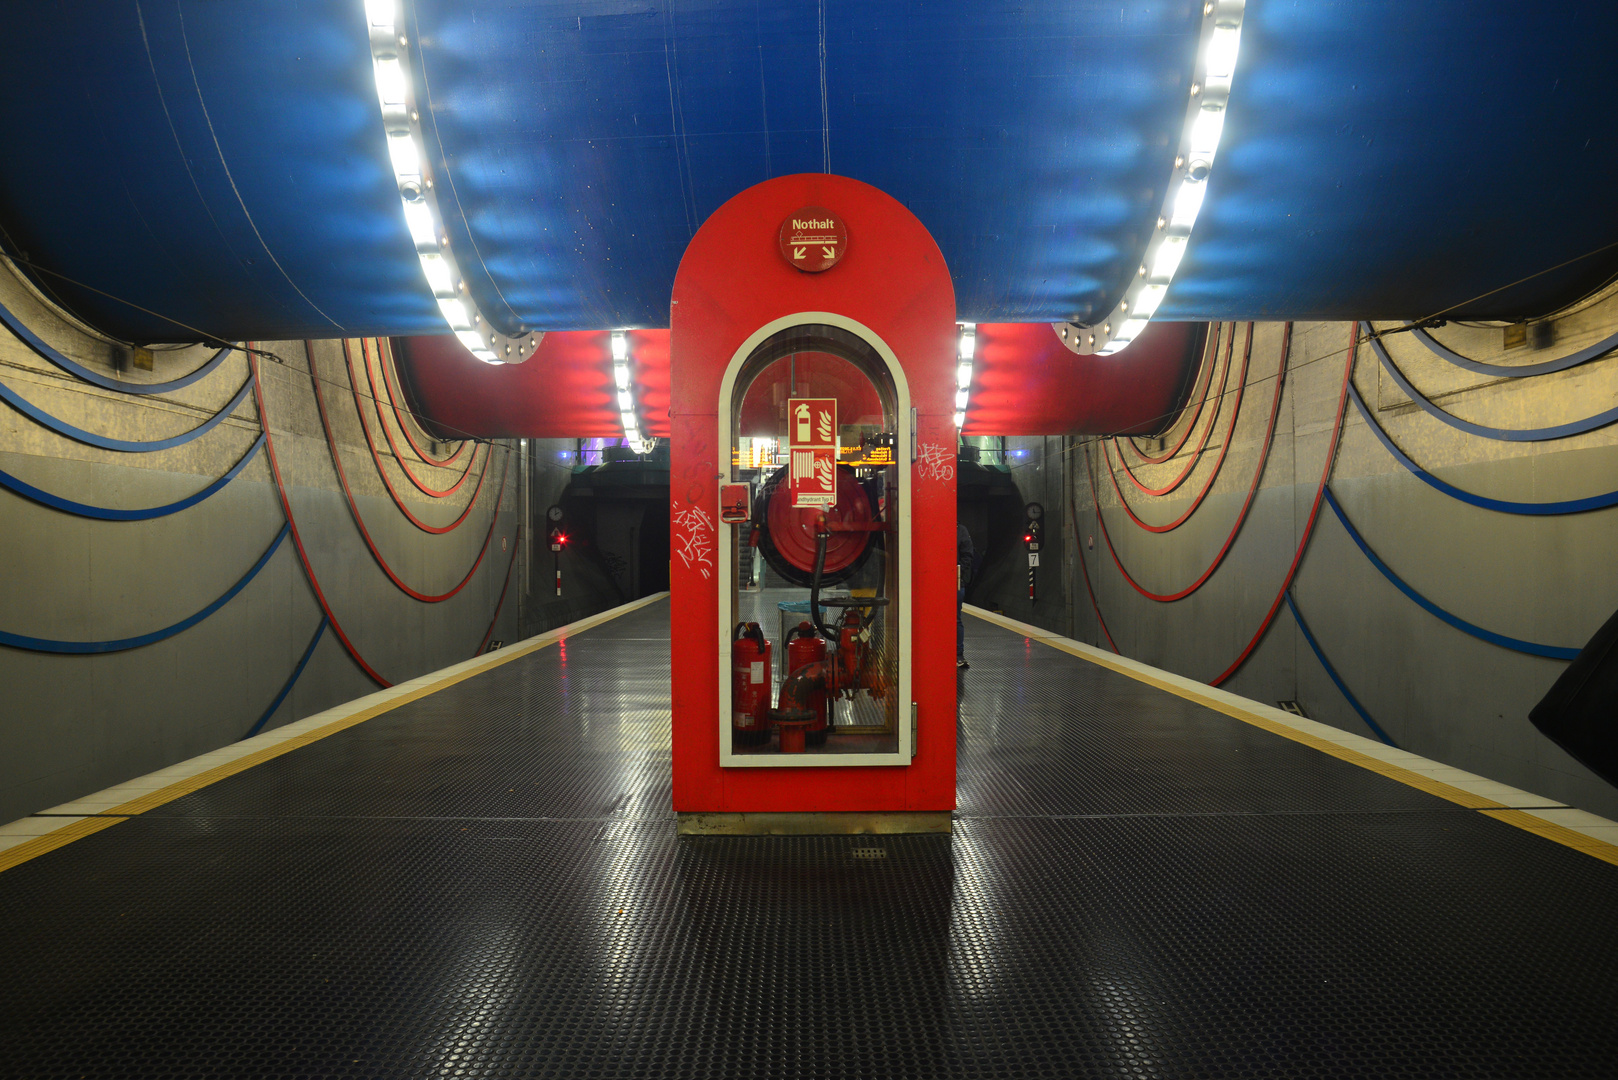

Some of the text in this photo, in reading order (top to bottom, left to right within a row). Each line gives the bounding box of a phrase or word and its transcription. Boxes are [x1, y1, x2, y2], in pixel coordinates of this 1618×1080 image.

[792, 218, 835, 230] Nothalt
[1030, 554, 1037, 565] 7
[489, 641, 502, 651] H
[1280, 702, 1304, 717] H
